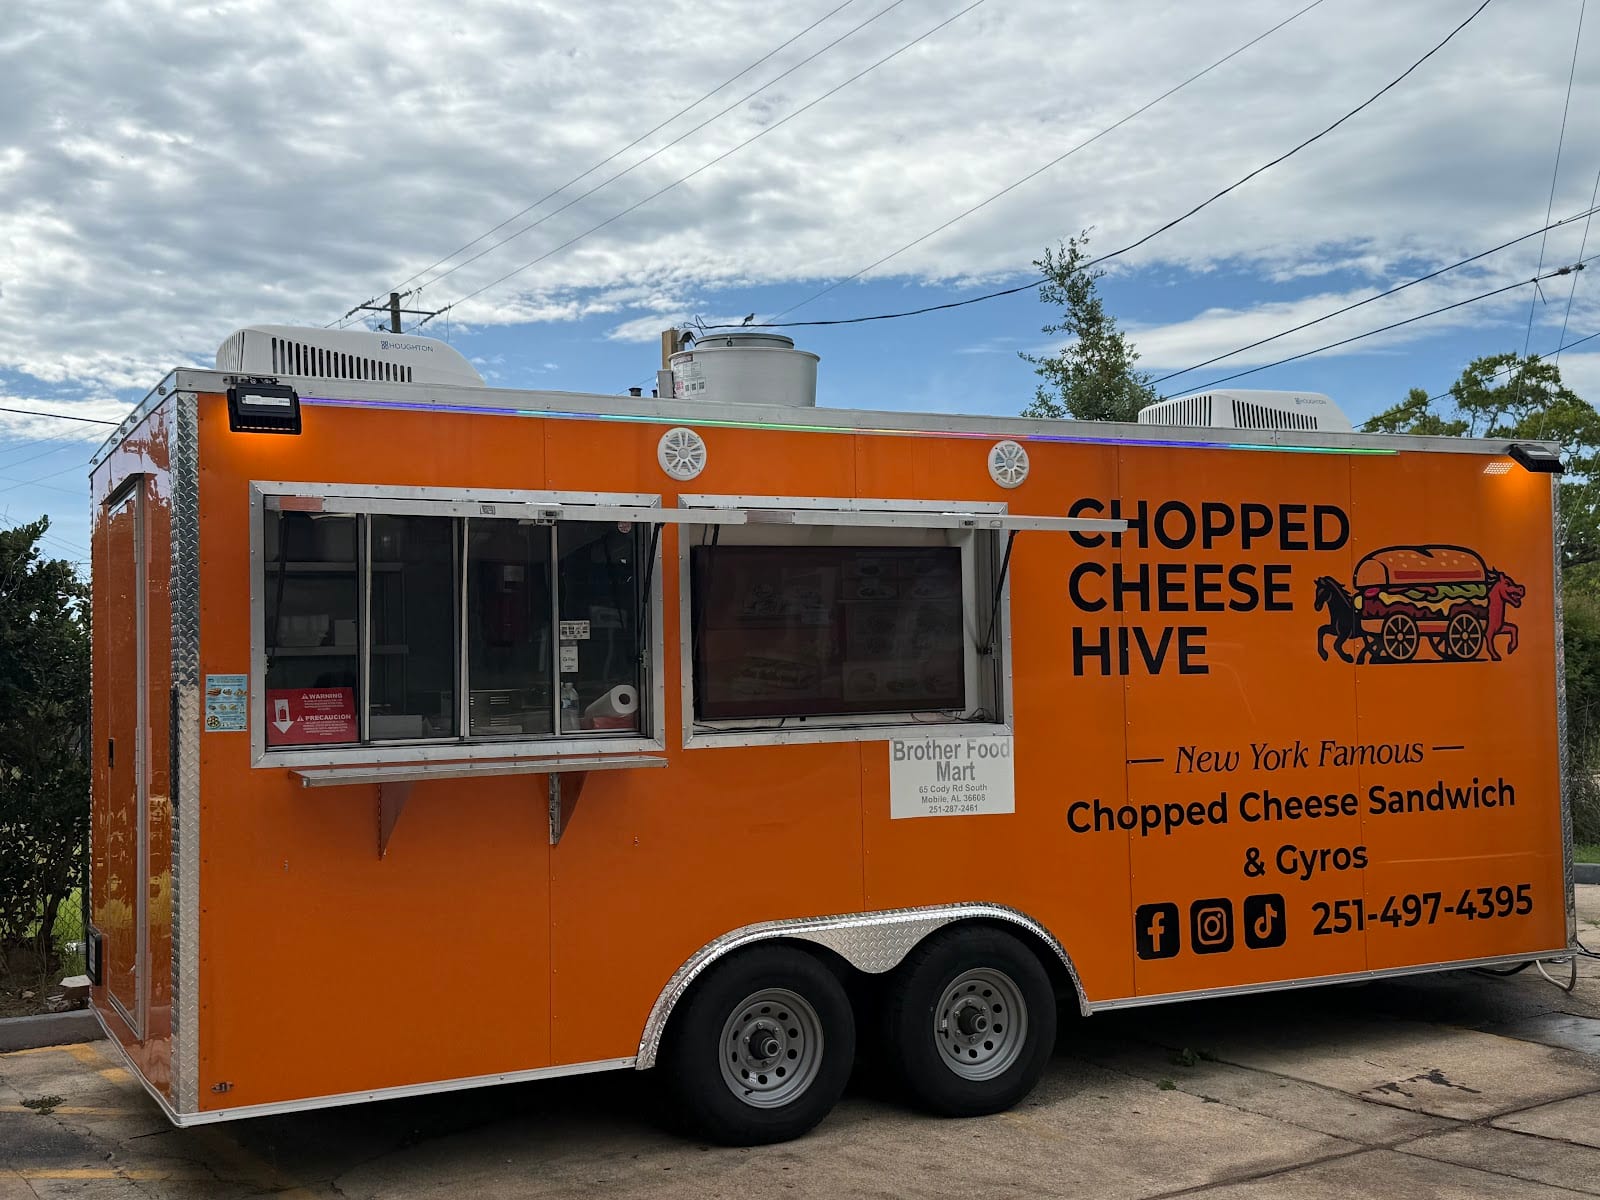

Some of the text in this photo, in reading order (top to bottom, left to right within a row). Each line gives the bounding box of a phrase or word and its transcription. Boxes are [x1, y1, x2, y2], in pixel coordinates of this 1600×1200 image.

[389, 343, 434, 352] HOUGHTON
[1067, 498, 1350, 550] CHOPPED
[1068, 562, 1293, 612] CHEESE
[1072, 627, 1209, 676] HIVE
[893, 738, 1010, 761] Brother Food
[1174, 738, 1424, 774] New York Famous
[930, 785, 950, 794] Cody
[952, 784, 963, 792] Rd
[965, 784, 987, 792] South
[936, 761, 975, 782] Mart
[929, 804, 978, 813] 251-287-2461
[951, 794, 961, 802] AL
[963, 793, 986, 801] 36608
[1066, 776, 1516, 837] Chopped Cheese Sandwich
[1243, 844, 1369, 882] & Gyros
[1312, 883, 1535, 936] 251-497-4395
